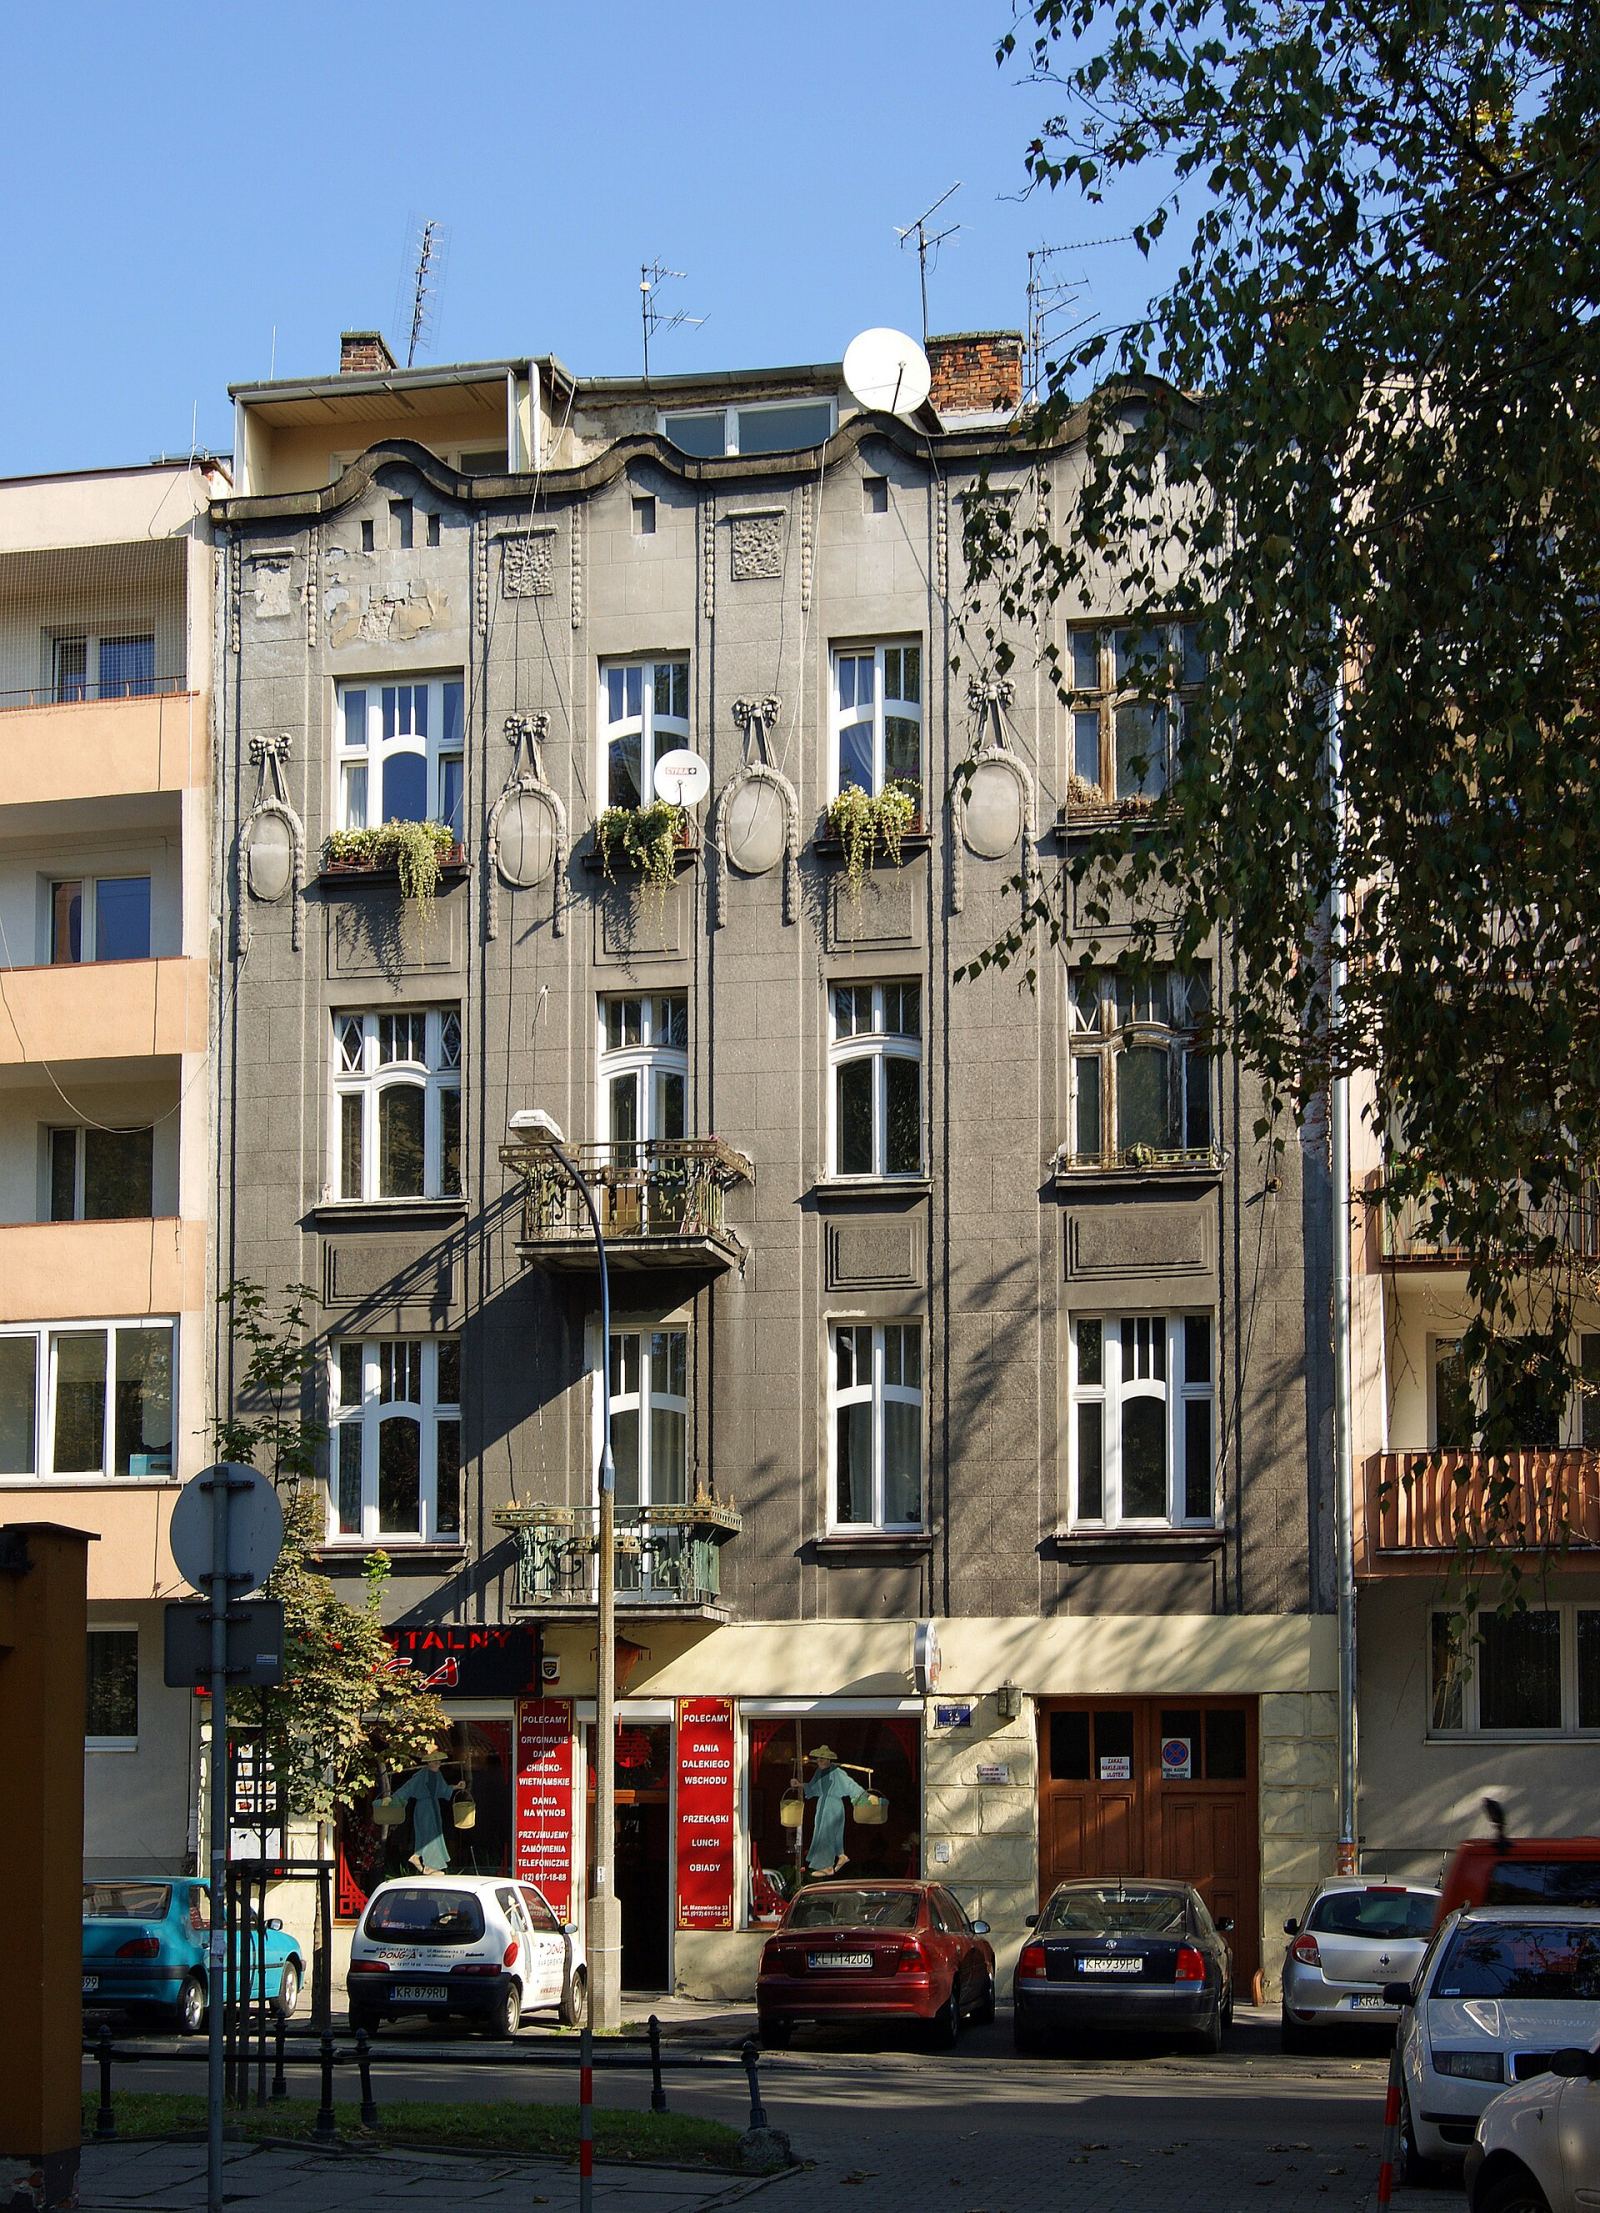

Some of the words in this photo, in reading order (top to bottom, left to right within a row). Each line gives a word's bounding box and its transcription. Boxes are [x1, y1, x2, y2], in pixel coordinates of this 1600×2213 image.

[522, 1715, 568, 1724] POLECAMY
[683, 1714, 729, 1723] POLECAMY
[521, 1736, 569, 1744] ORYGINALNE
[693, 1744, 719, 1752] DANIA
[682, 1760, 730, 1768] DALEKIEGO
[519, 1777, 570, 1786] WIETNAMSKIE
[684, 1776, 727, 1784] WSCHODU
[532, 1797, 557, 1805] DANIA
[523, 1809, 535, 1817] NA
[536, 1809, 566, 1817] WYNOS
[683, 1814, 729, 1825] PRZEKĄSKI
[518, 1831, 569, 1839] PRZYJMUJEMY
[691, 1839, 720, 1847] LUNCH
[521, 1843, 566, 1853] ZAMÓWIENIA
[518, 1859, 570, 1867] TELEFONICZNE
[689, 1864, 720, 1872] OBIADY
[378, 1951, 417, 1959] DONG-A
[838, 1952, 869, 1965] 14206
[1086, 1959, 1102, 1969] KR
[1105, 1958, 1141, 1969] 939PC
[396, 1987, 411, 1998] KR
[414, 1987, 446, 1998] 879RU
